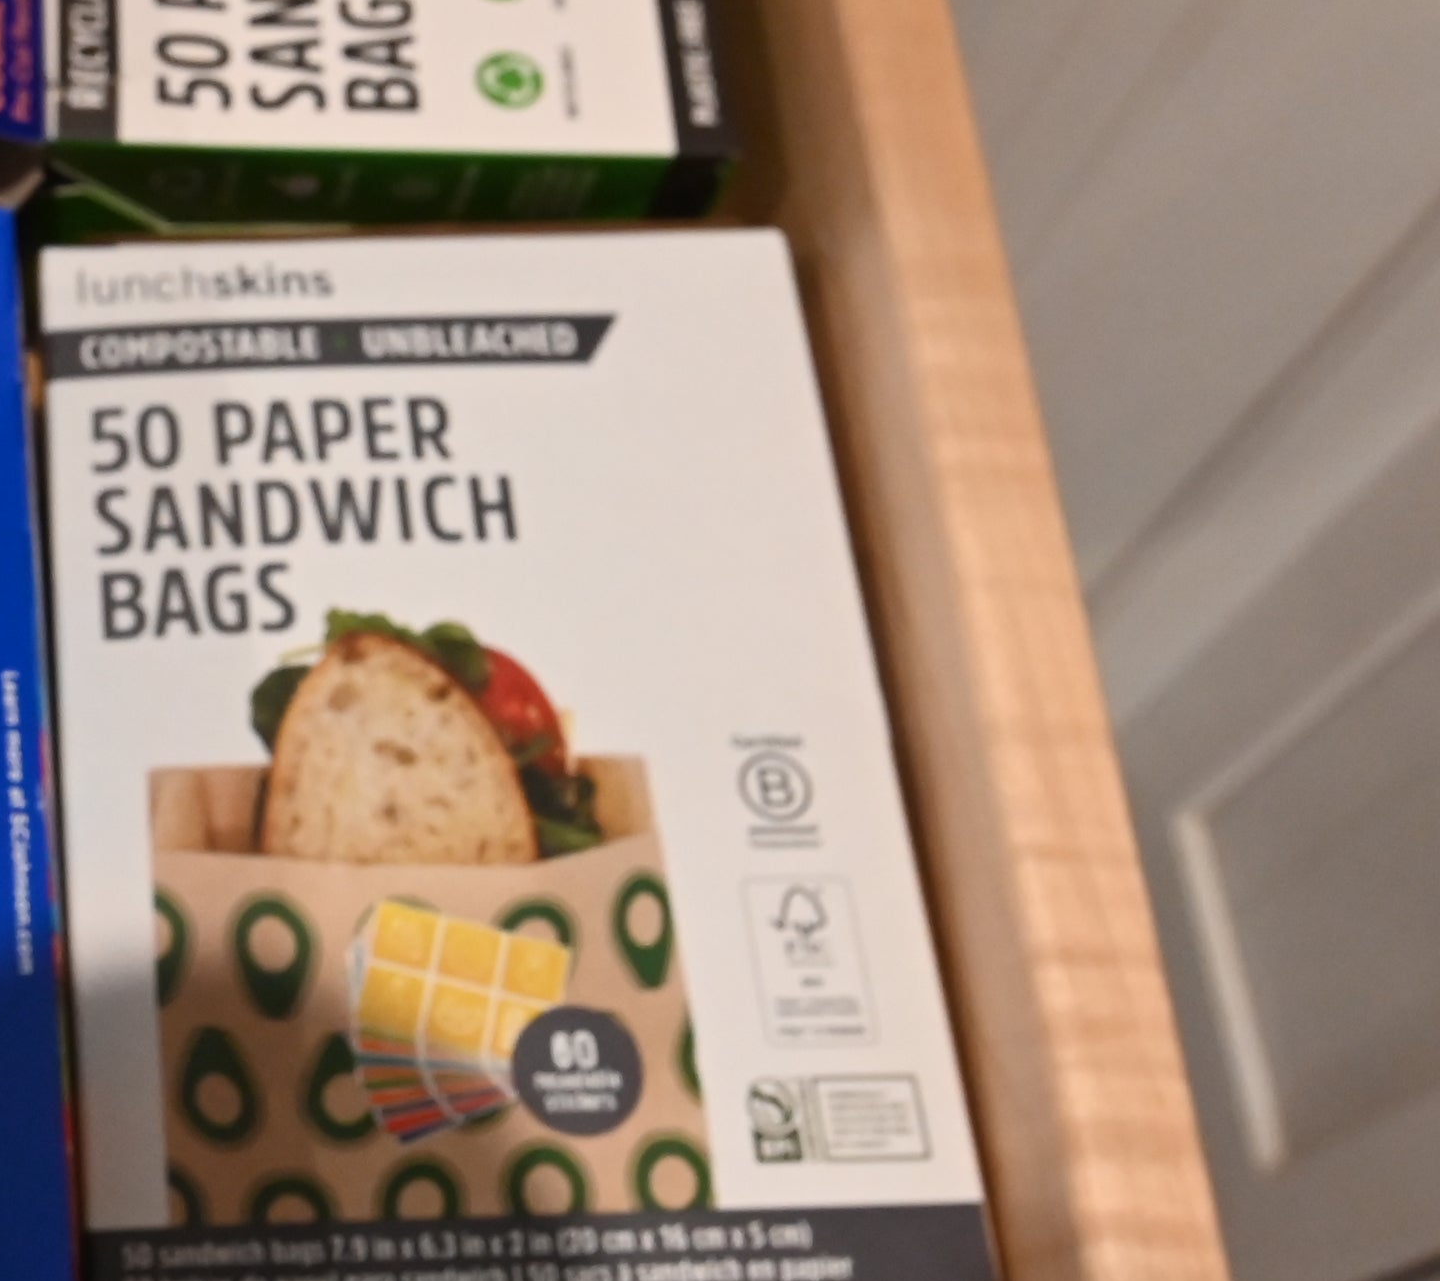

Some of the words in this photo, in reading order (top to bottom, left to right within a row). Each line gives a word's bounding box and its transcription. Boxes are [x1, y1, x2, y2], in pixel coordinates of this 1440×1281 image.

[157, 32, 233, 112] 50
[76, 262, 336, 306] lunchskins
[80, 326, 320, 370] COMPOSTABLE
[359, 324, 577, 359] UNBLEACHED
[90, 405, 181, 474] 50
[212, 396, 452, 467] PAPER
[95, 474, 520, 558] SANDWICH
[101, 562, 297, 641] BAGS
[0, 670, 18, 726] Learn
[6, 729, 22, 782] more
